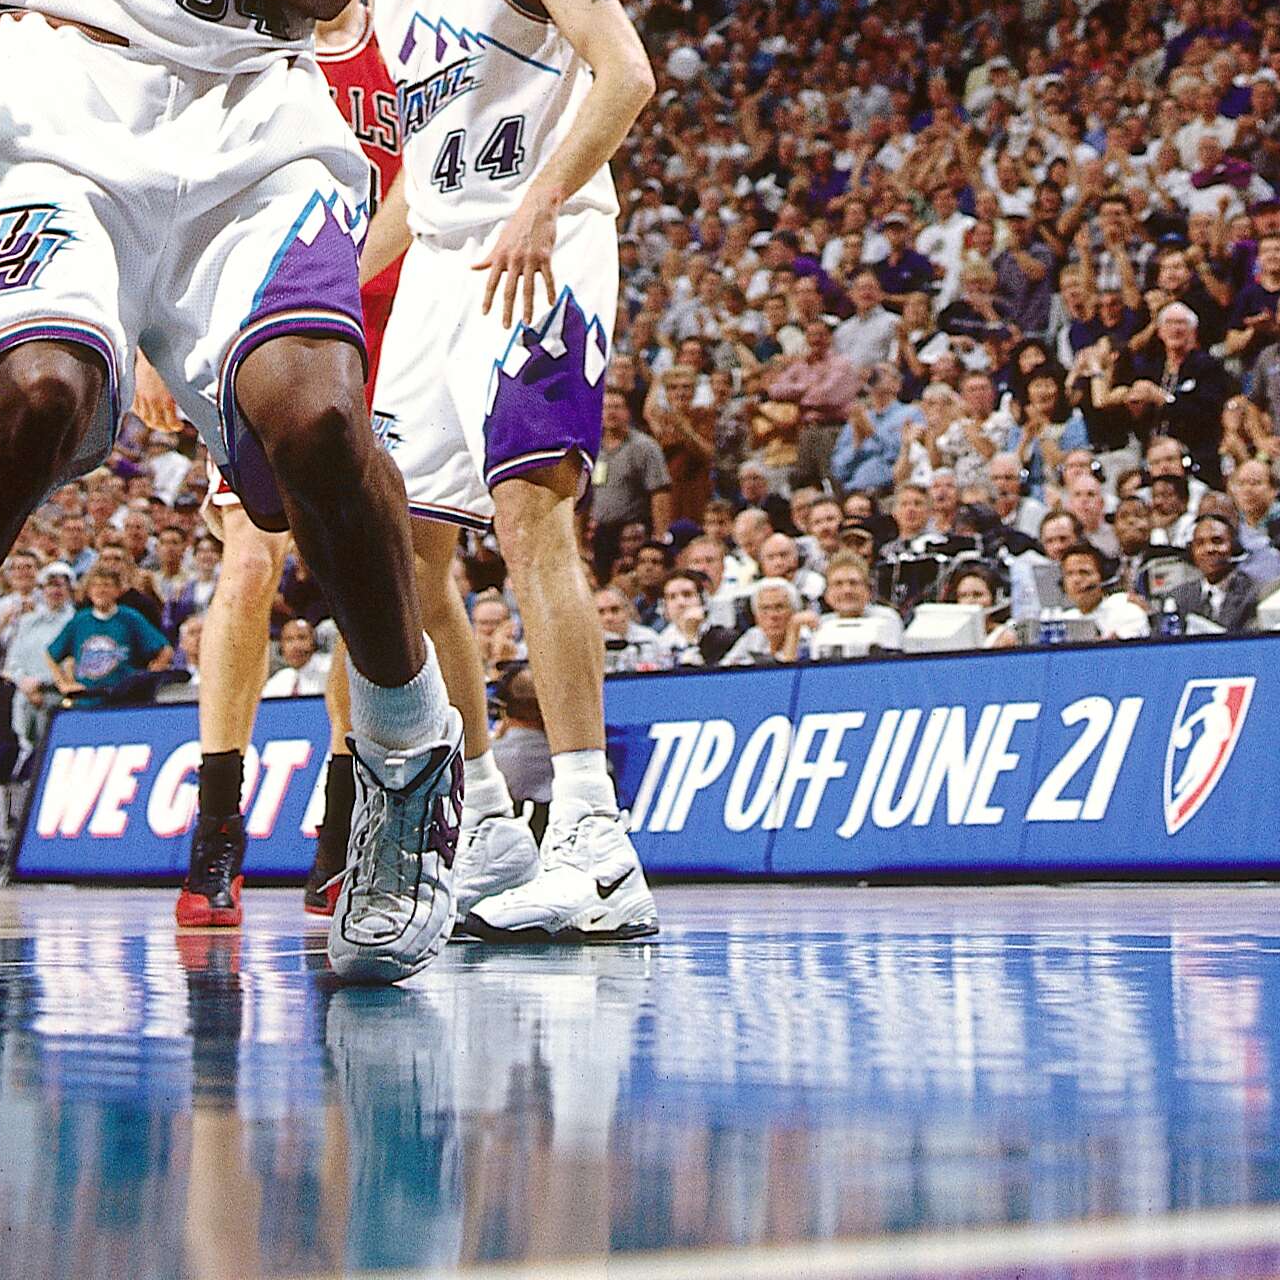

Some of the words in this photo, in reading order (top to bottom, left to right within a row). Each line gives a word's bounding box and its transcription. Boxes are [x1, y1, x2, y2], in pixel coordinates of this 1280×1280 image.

[431, 114, 525, 193] 44
[36, 743, 152, 839] WE
[147, 739, 313, 839] GT
[631, 720, 737, 833] TIP
[723, 711, 866, 832] OFF
[836, 702, 1042, 840] JUNE
[1026, 696, 1144, 822] 21
